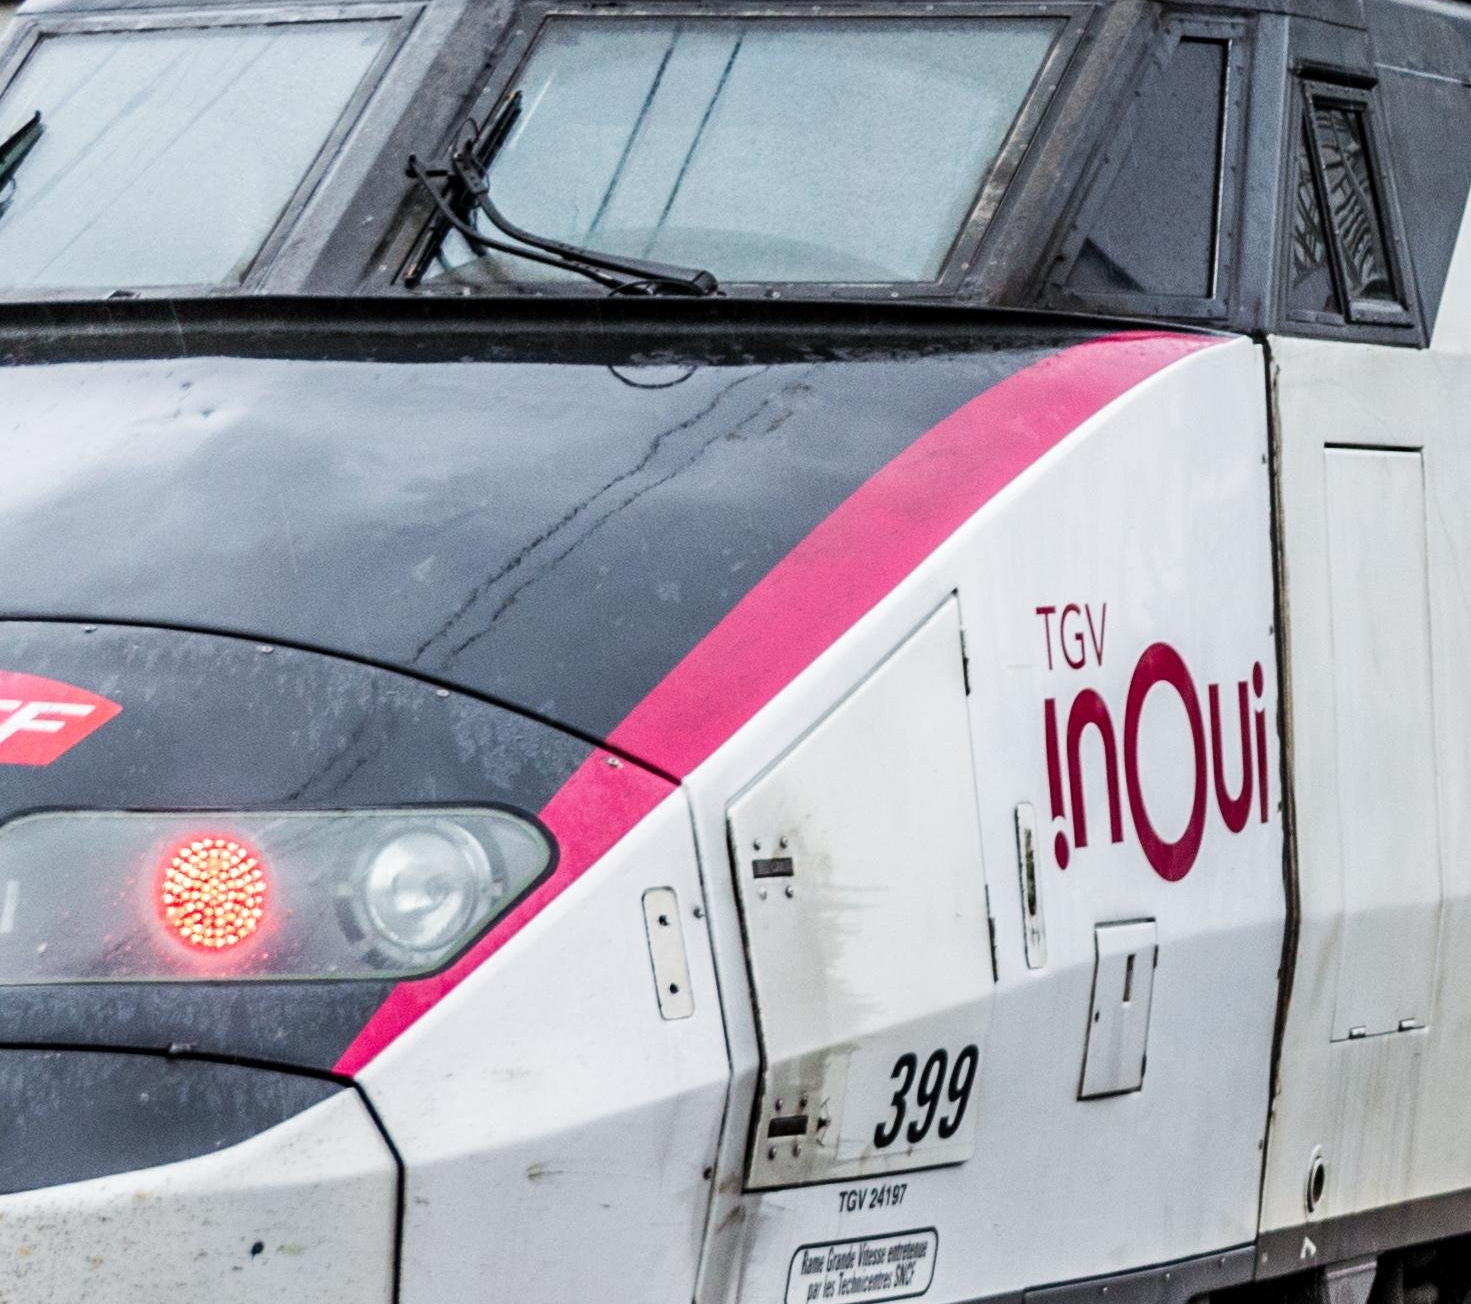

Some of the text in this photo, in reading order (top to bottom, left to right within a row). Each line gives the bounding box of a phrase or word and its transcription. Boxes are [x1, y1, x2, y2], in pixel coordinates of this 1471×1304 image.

[1036, 602, 1107, 671] TGV
[873, 1043, 980, 1149] 399
[839, 1183, 908, 1213] TGV 24197
[801, 1250, 825, 1275] Rame
[826, 1244, 856, 1272] Grande
[857, 1242, 887, 1268] Vitesse
[807, 1280, 823, 1301] par
[823, 1276, 836, 1299] les
[894, 1261, 918, 1288] SNCF
